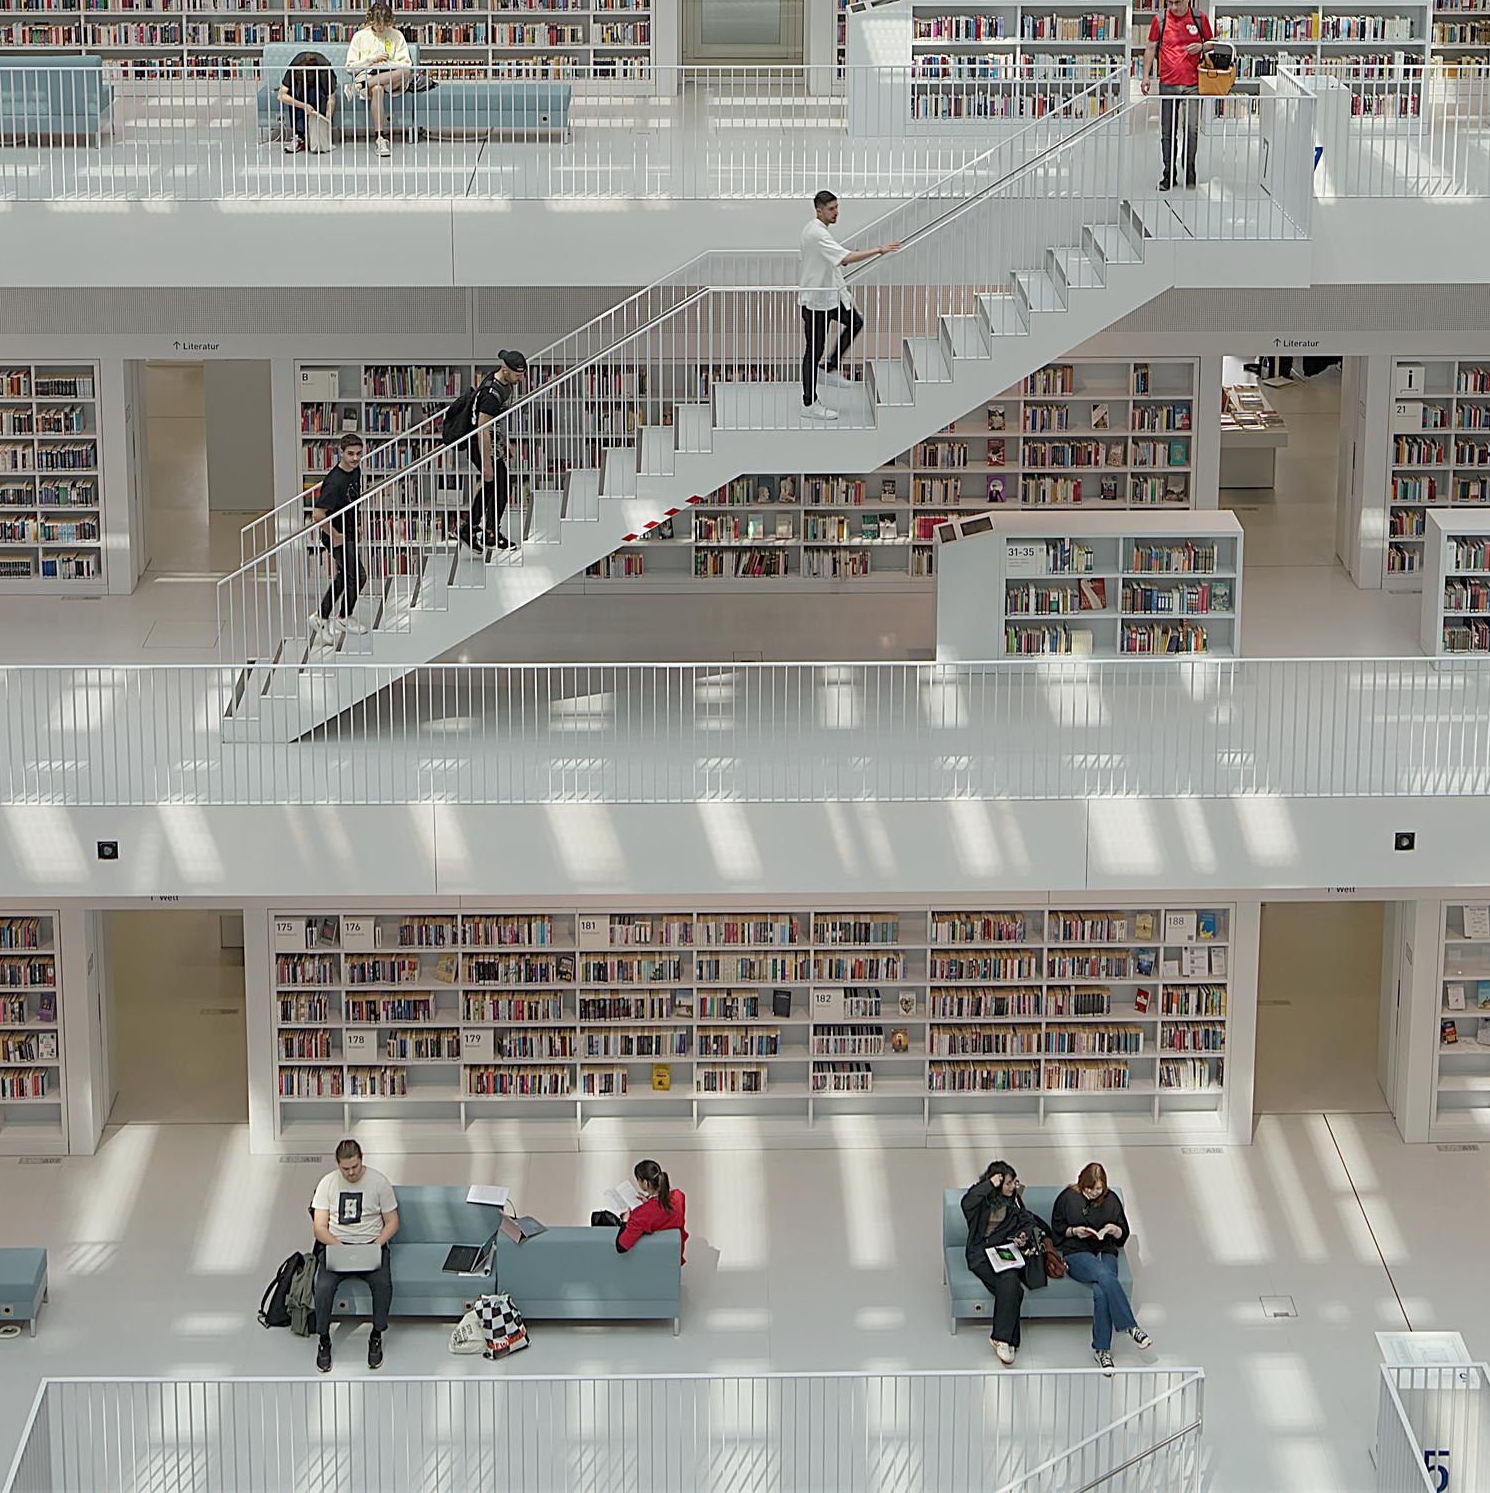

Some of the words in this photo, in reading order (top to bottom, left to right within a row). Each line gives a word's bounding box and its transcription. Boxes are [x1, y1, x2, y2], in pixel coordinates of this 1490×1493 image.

[182, 342, 220, 351] Literatur
[1283, 339, 1320, 348] Literatur
[301, 372, 309, 382] B
[1396, 405, 1406, 414] 21
[1008, 547, 1035, 558] 31-35
[581, 921, 596, 930] 181
[1168, 916, 1185, 926] 188
[276, 922, 293, 932] 175
[345, 922, 361, 932] 176
[815, 994, 831, 1003] 182
[348, 1035, 365, 1044] 178
[465, 1034, 481, 1044] 179
[1422, 1449, 1450, 1493] 5
